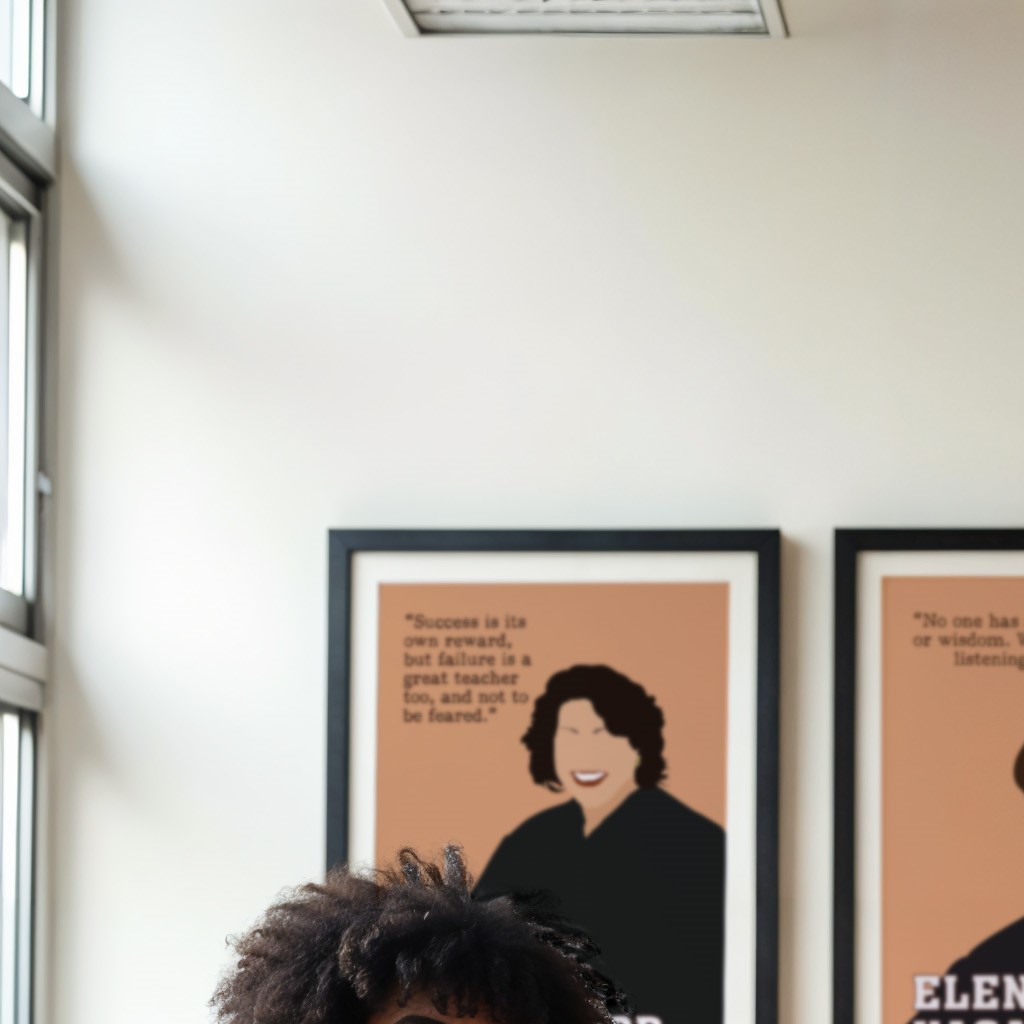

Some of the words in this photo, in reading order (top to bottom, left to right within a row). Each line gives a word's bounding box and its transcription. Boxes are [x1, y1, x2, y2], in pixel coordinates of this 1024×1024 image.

[404, 613, 480, 629] "Success
[483, 614, 500, 629] is
[504, 614, 528, 629] its
[912, 611, 948, 629] "No
[952, 615, 983, 629] one
[988, 613, 1020, 629] has
[403, 635, 438, 648] own
[445, 632, 513, 650] reward,
[912, 634, 933, 647] or
[938, 632, 1010, 647] wisdom.
[403, 652, 432, 666] but
[438, 651, 496, 667] failure
[502, 653, 517, 667] is
[520, 654, 533, 667] a
[402, 671, 448, 690] great
[454, 670, 519, 686] teacher
[402, 690, 435, 706] too,
[441, 689, 473, 704] and
[478, 690, 506, 704] not
[511, 690, 530, 704] to
[402, 707, 423, 723] be
[427, 706, 498, 723] feared."
